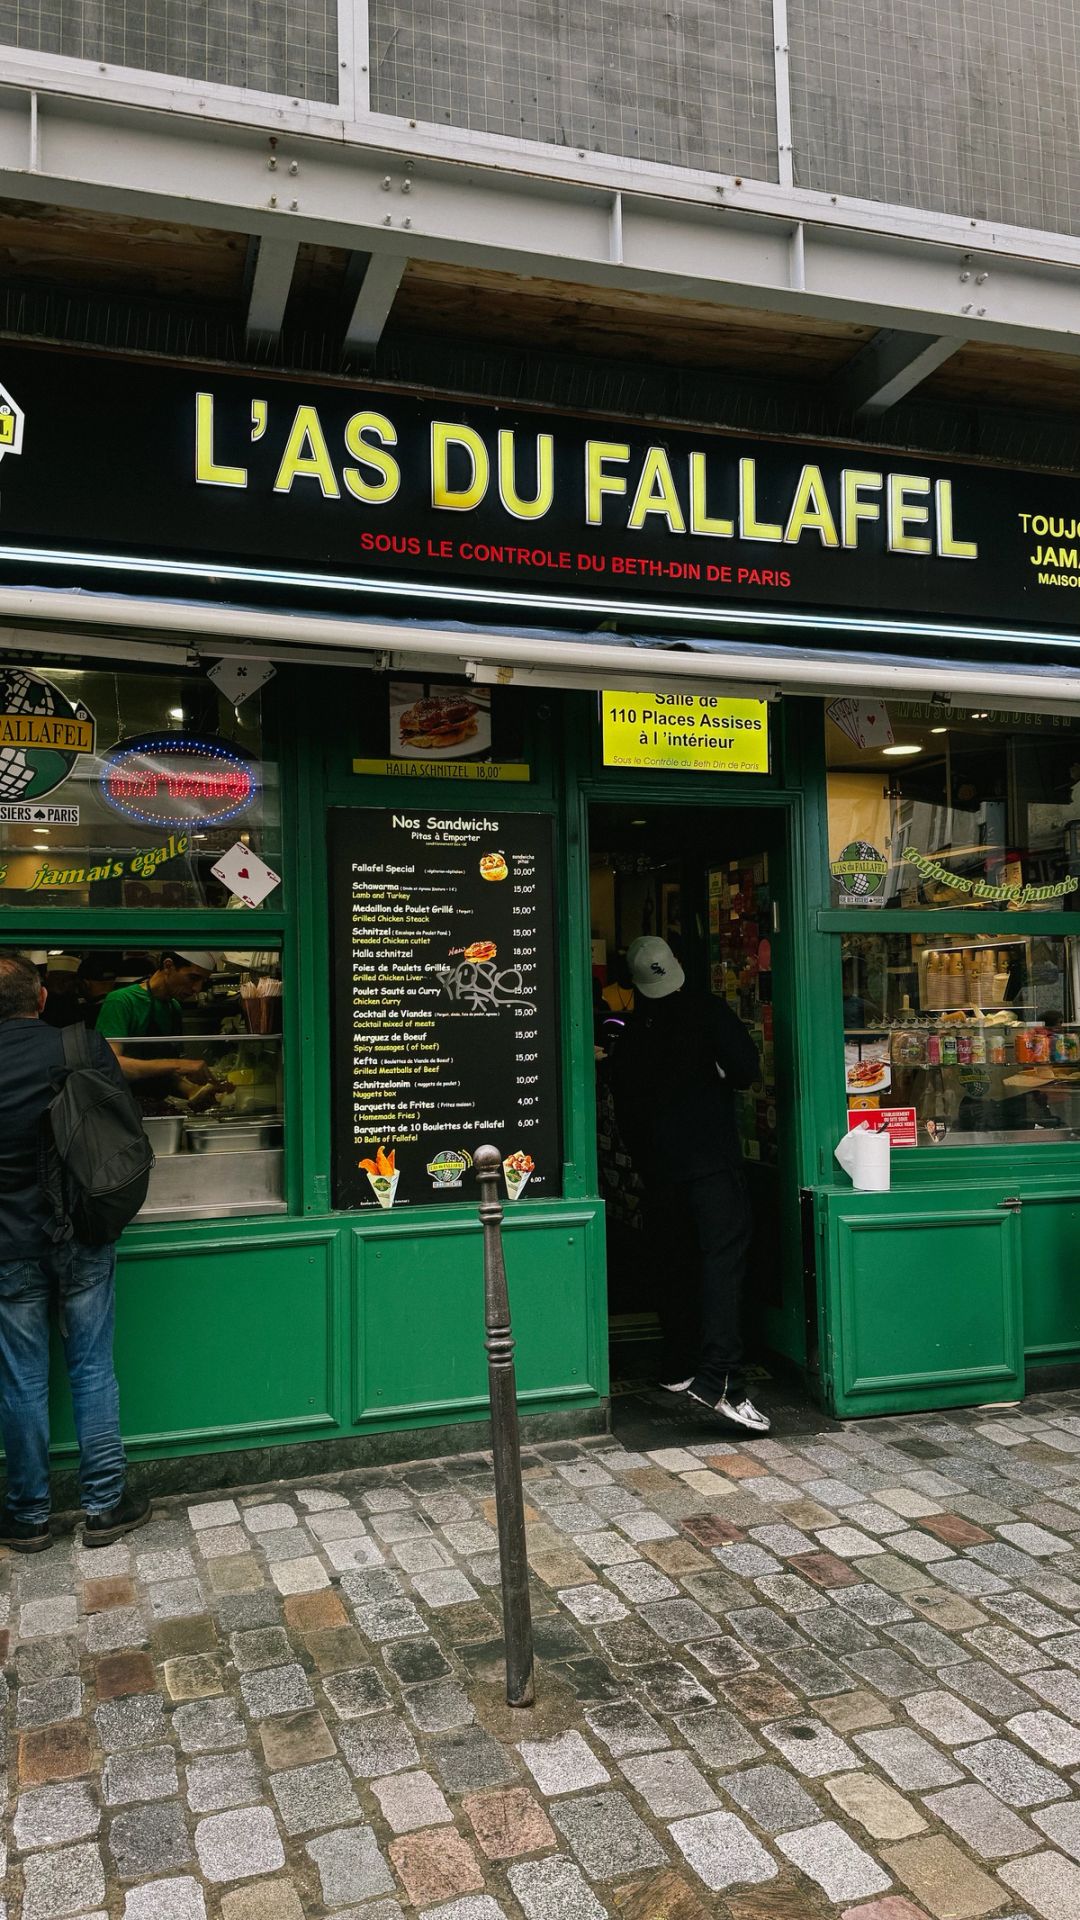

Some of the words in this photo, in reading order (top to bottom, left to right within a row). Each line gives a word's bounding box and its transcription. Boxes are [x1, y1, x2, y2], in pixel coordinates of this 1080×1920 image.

[195, 392, 401, 504] L'AS
[431, 421, 554, 520] DU
[585, 440, 978, 559] FALLAFEL
[1018, 513, 1080, 539] TOUJ
[360, 533, 421, 555] SOUS
[428, 540, 453, 558] LE
[459, 543, 571, 569] CONTROLE
[577, 554, 605, 572] DU
[611, 557, 700, 580] BETH-DIN
[706, 565, 732, 583] DE
[738, 568, 791, 587] PARIS
[1030, 545, 1080, 569] JAM
[1038, 572, 1080, 588] MAISO
[655, 694, 694, 706] Salle
[610, 708, 637, 724] 110
[643, 710, 695, 727] Places
[700, 714, 762, 730] Assises
[0, 719, 88, 747] ALLAFEL
[639, 730, 648, 745] à
[612, 755, 632, 764] Sous
[634, 756, 642, 765] le
[643, 756, 680, 767] Contrôle
[681, 758, 692, 767] du
[694, 759, 711, 768] Beth
[713, 760, 725, 769] Din
[727, 761, 738, 770] de
[741, 761, 759, 770] Paris
[386, 763, 418, 776] HALLA
[420, 764, 469, 778] SCHNITZEL
[48, 808, 78, 822] PARIS
[392, 815, 420, 829] Nos
[426, 817, 499, 831] Sandwichs
[411, 832, 432, 840] Pitas
[434, 832, 440, 841] à
[443, 833, 481, 842] Emporter
[26, 858, 124, 892] jamais
[130, 831, 189, 877] égalé
[352, 863, 383, 872] Fallafel
[385, 865, 415, 874] Special
[902, 847, 973, 892] toujours
[974, 879, 1021, 901] imité
[1019, 874, 1078, 907] jamais
[352, 882, 399, 890] Schawarma
[352, 891, 371, 899] Lamb
[386, 892, 410, 900] Turkey
[352, 904, 391, 913] Medaillon
[393, 904, 403, 913] de
[405, 905, 430, 913] Poulet
[431, 905, 454, 914] Grillé
[352, 927, 391, 936] Schnitzel
[352, 949, 374, 958] Halla
[376, 949, 413, 958] schnitzel
[353, 963, 375, 972] Foies
[378, 963, 388, 972] de
[392, 963, 422, 972] Poulets
[353, 987, 379, 995] Poulet
[380, 986, 405, 995] Sauté
[418, 987, 441, 997] Curry
[381, 998, 401, 1006] Curry
[353, 1010, 386, 1018] Cocktail
[388, 1010, 399, 1018] de
[401, 1010, 432, 1018] Viandes
[353, 1033, 389, 1043] Merguez
[391, 1033, 401, 1041] de
[353, 1044, 373, 1053] Spicy
[374, 1044, 404, 1052] sausages
[353, 1057, 378, 1065] Kefta
[353, 1067, 377, 1075] Grilled
[379, 1066, 412, 1074] Meatballs
[423, 1065, 440, 1073] Beef
[353, 1080, 411, 1089] Schnitzelonim
[353, 1090, 382, 1099] Nuggets
[353, 1103, 396, 1112] Barquette
[397, 1101, 408, 1110] de
[409, 1101, 435, 1109] Frites
[353, 1126, 396, 1135] Barquette
[397, 1124, 408, 1132] de
[410, 1123, 421, 1131] 10
[422, 1122, 461, 1131] Boulettes
[462, 1121, 473, 1129] de
[474, 1120, 505, 1129] Fallafel
[354, 1136, 363, 1144] 10
[391, 1134, 418, 1142] Fallafel
